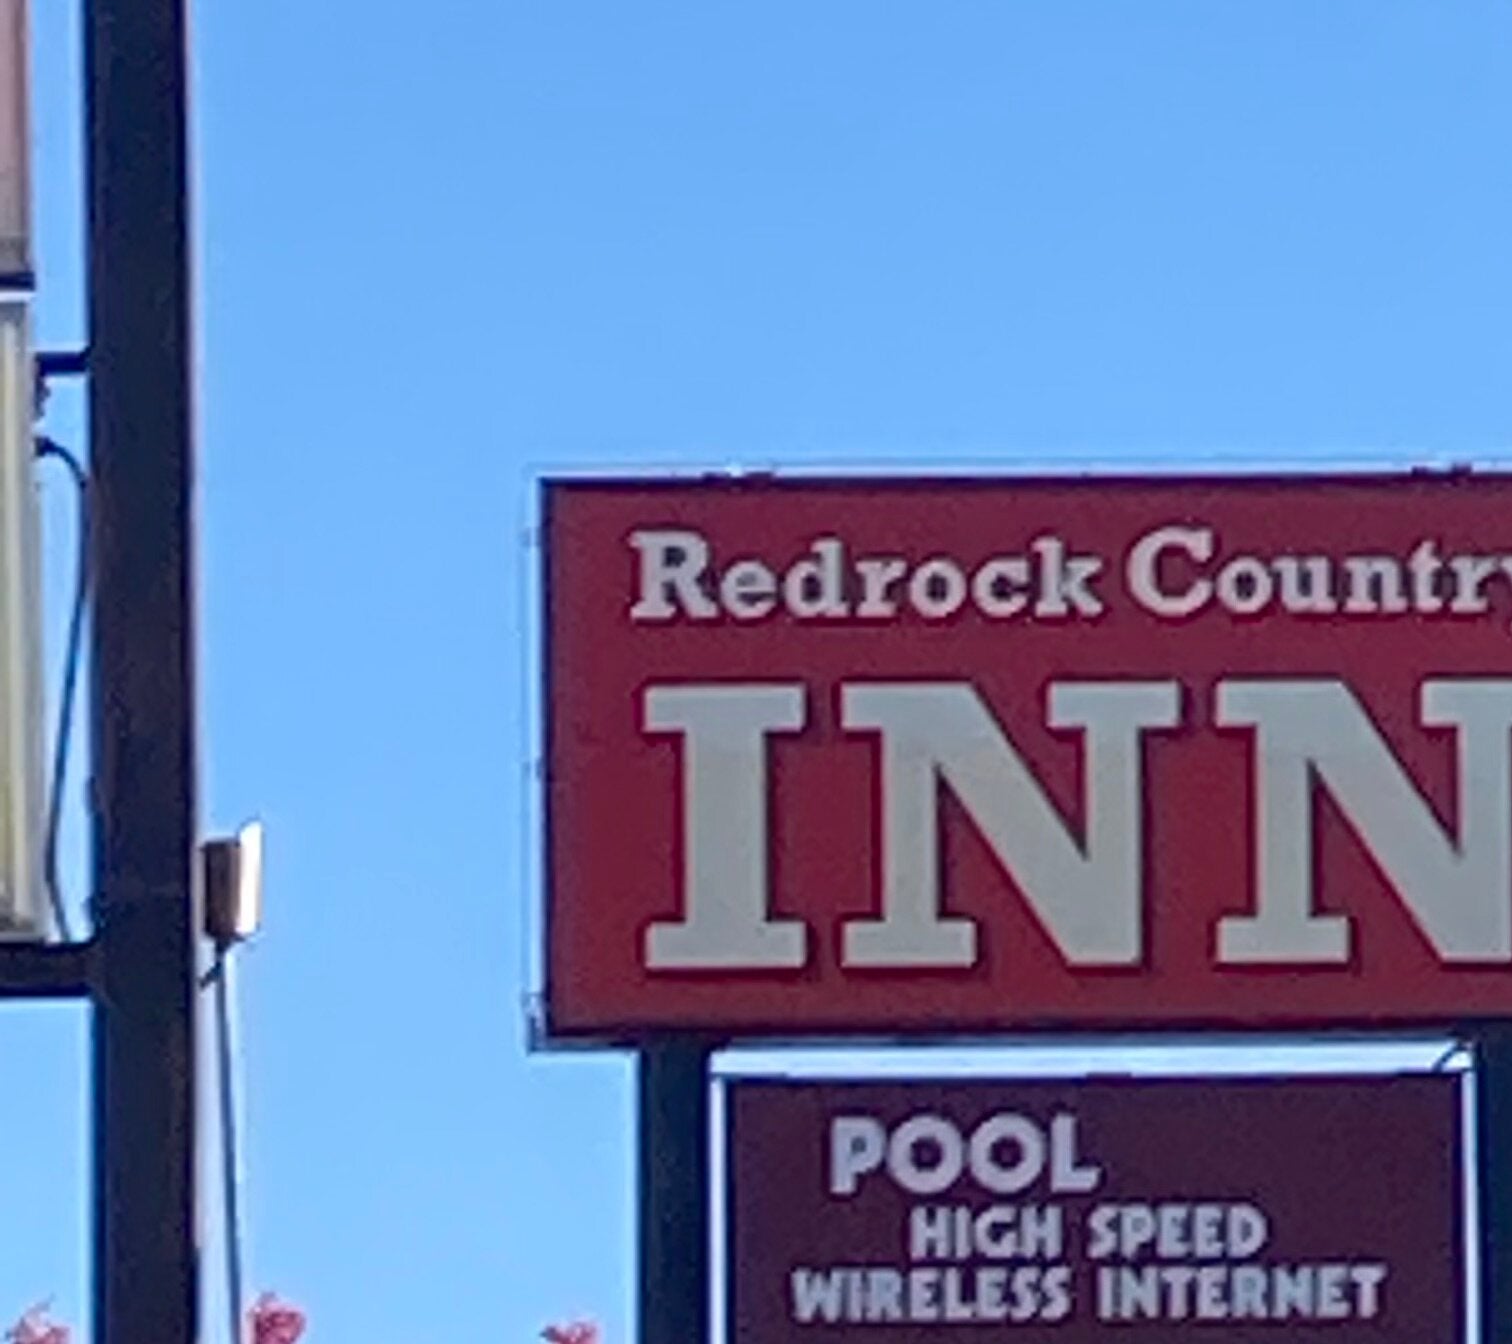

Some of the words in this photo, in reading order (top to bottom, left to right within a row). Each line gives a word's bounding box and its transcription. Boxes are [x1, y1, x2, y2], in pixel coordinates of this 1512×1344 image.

[630, 530, 1103, 620] Redrock
[830, 1114, 1101, 1195] POOL
[910, 1205, 1062, 1259] HIGH
[1088, 1204, 1267, 1258] SPEED
[791, 1266, 1071, 1322] WIRELESS
[1099, 1265, 1386, 1319] INTERNET
